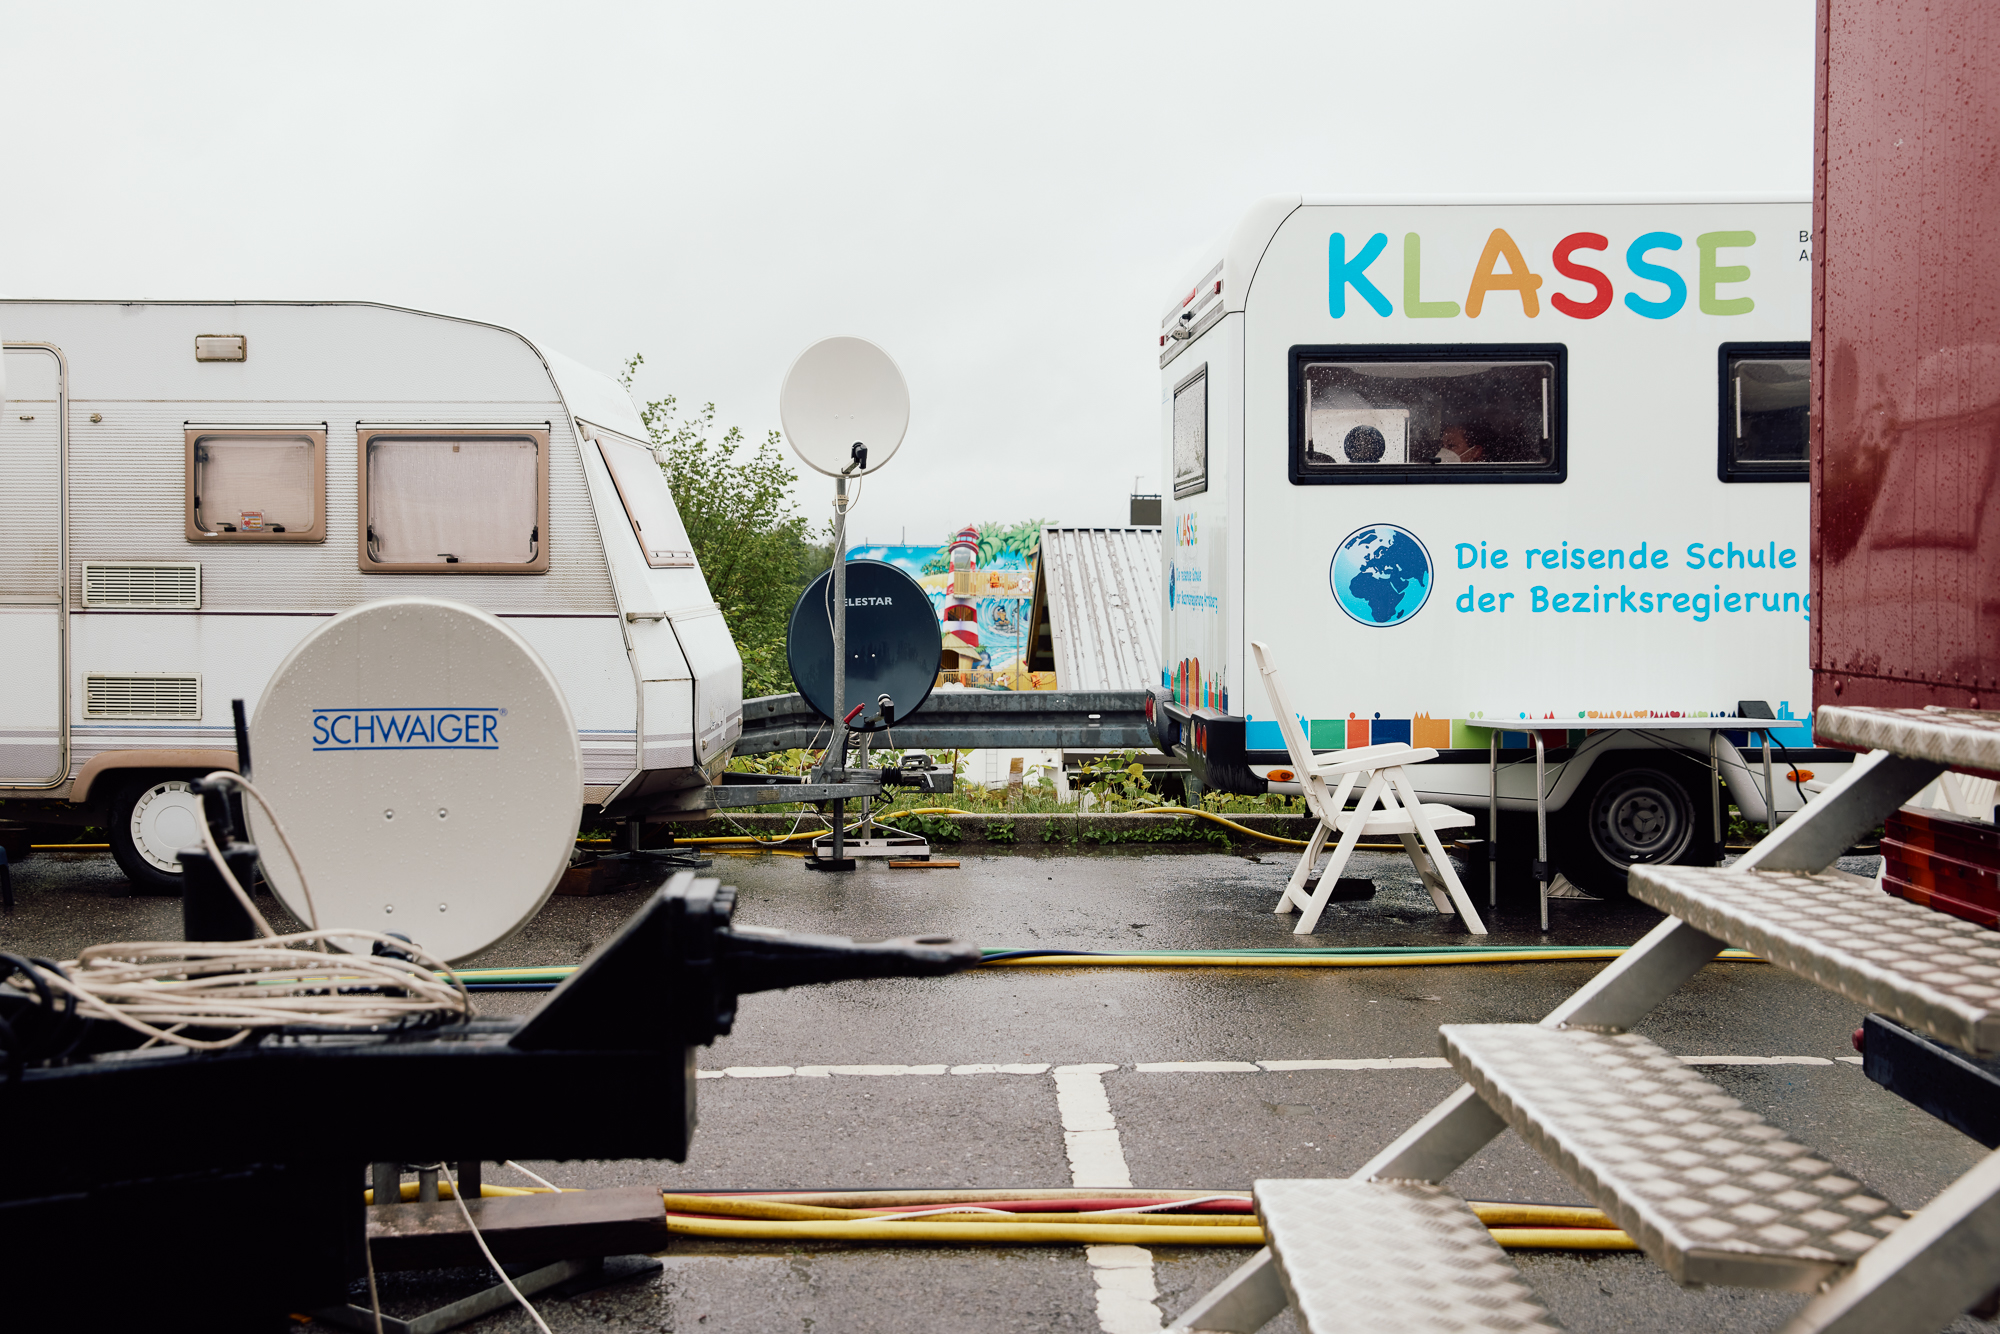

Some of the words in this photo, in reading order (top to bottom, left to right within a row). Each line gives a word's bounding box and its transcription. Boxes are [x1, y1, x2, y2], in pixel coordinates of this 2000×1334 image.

[1329, 228, 1756, 320] KLASSE
[1176, 512, 1197, 546] KLASSE
[1455, 541, 1508, 569] Die
[1525, 541, 1669, 569] reisende
[1686, 541, 1797, 569] Schule
[833, 597, 893, 607] LESTAR
[1456, 584, 1515, 613] der
